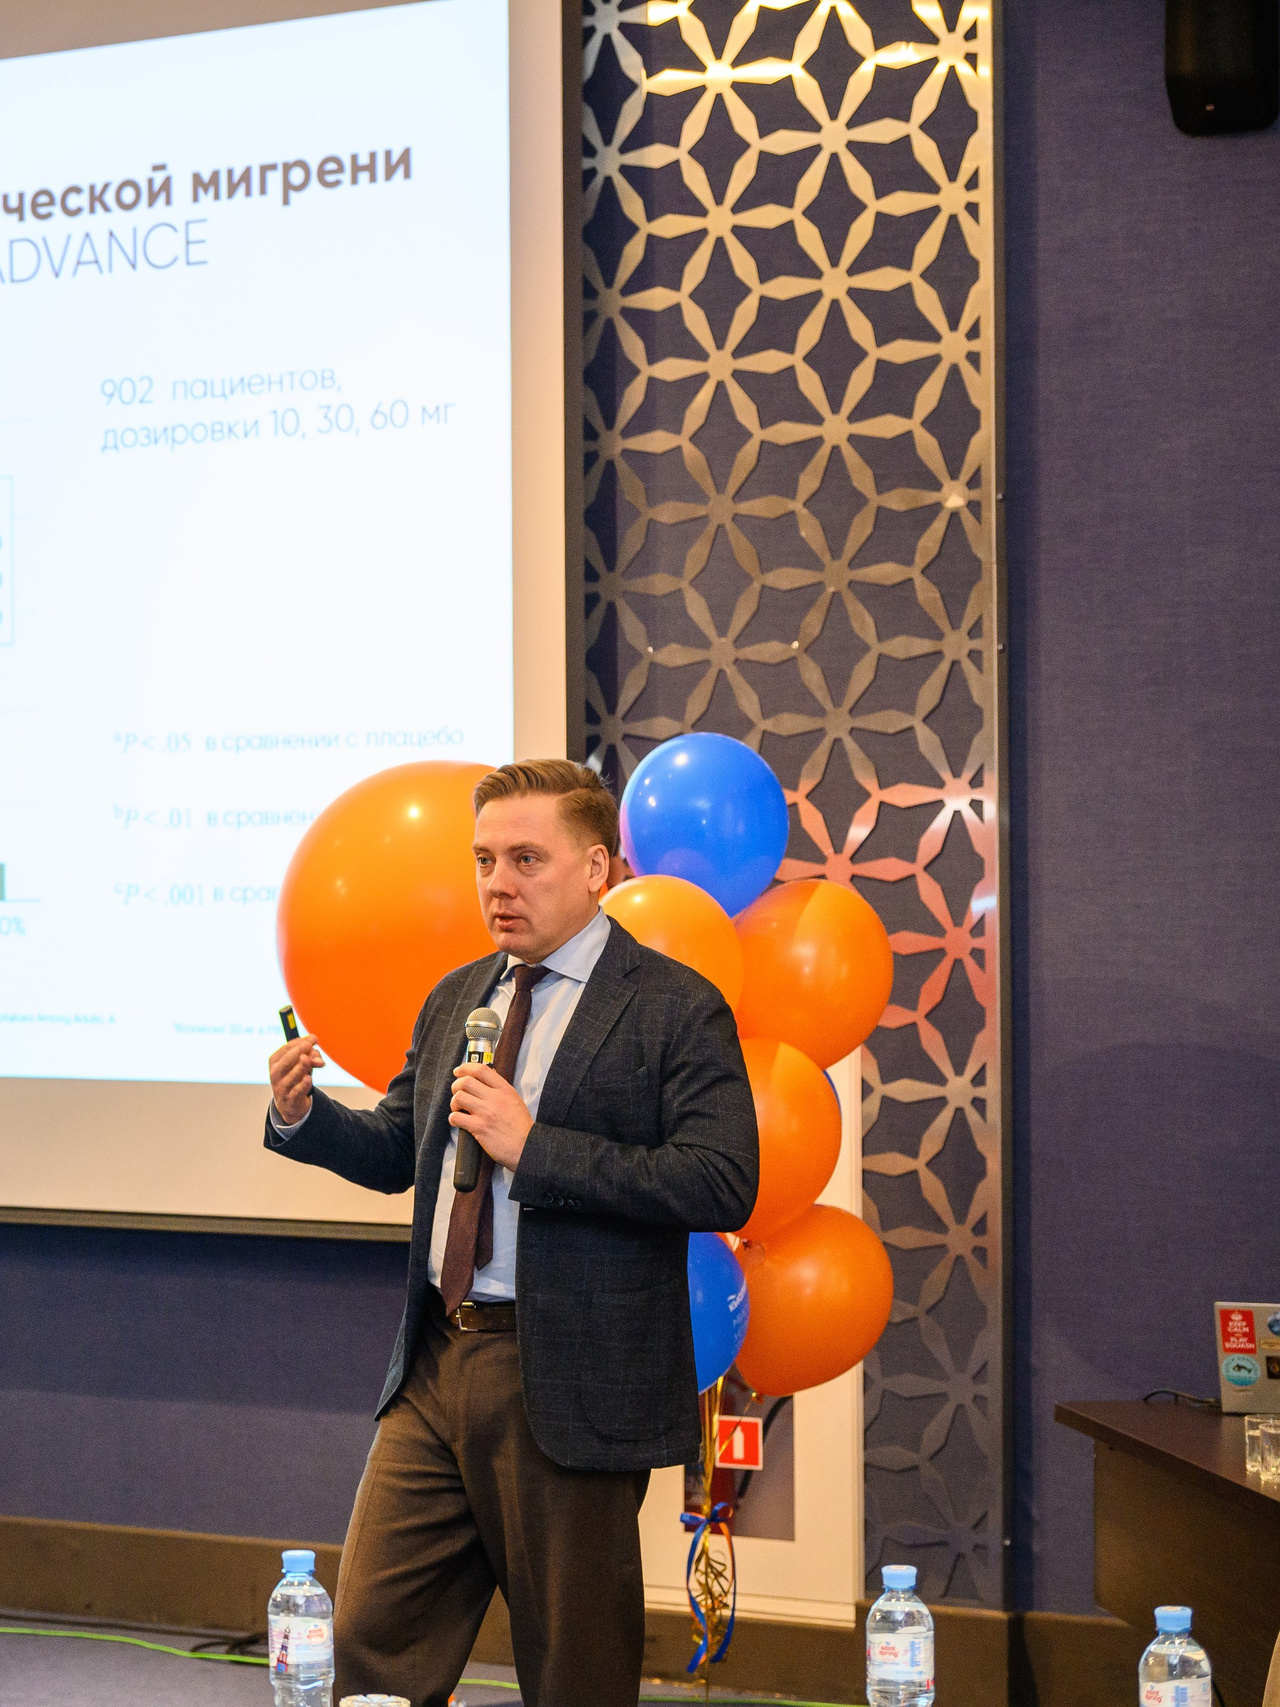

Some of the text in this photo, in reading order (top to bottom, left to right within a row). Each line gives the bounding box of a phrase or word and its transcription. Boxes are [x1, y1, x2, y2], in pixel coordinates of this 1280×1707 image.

[191, 146, 413, 207] мигрени
[100, 367, 343, 406] 902 пациентов,
[100, 398, 457, 454] дозировки 10, 30, 60 мг
[221, 732, 340, 754] сравнении
[345, 733, 359, 747] с
[366, 725, 465, 748] плацебо
